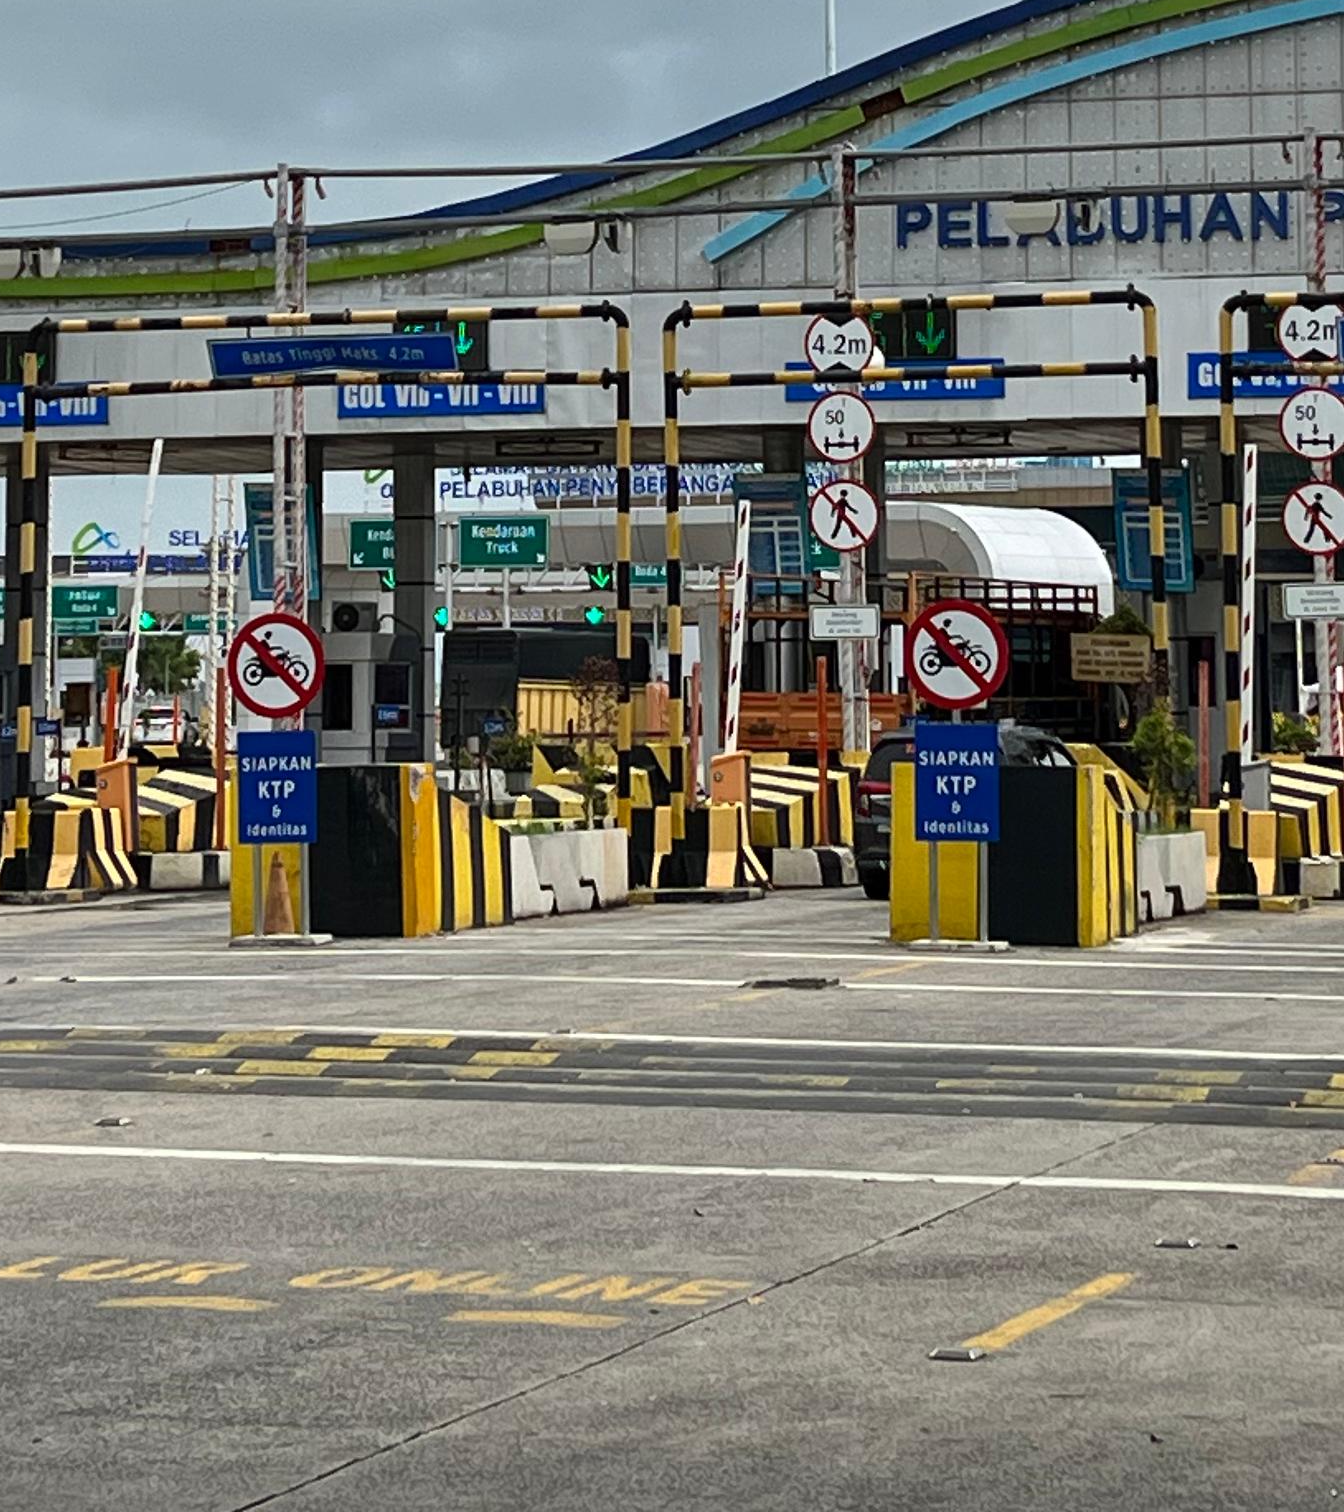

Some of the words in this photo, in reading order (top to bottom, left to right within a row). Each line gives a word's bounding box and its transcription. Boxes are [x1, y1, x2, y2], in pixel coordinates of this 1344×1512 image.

[812, 334, 868, 355] 4.2m
[242, 349, 284, 366] Batas
[288, 345, 336, 363] Tinggi
[343, 384, 386, 408] GOL
[825, 410, 844, 425] 50
[1295, 405, 1316, 421] 50
[242, 756, 311, 772] SIAPKAN
[919, 750, 994, 766] SIAPKAN
[258, 780, 295, 799] KTP
[936, 776, 976, 795] KTP
[247, 822, 307, 837] Identitas
[924, 819, 989, 834] Identitas
[287, 1265, 754, 1306] ONLINE
